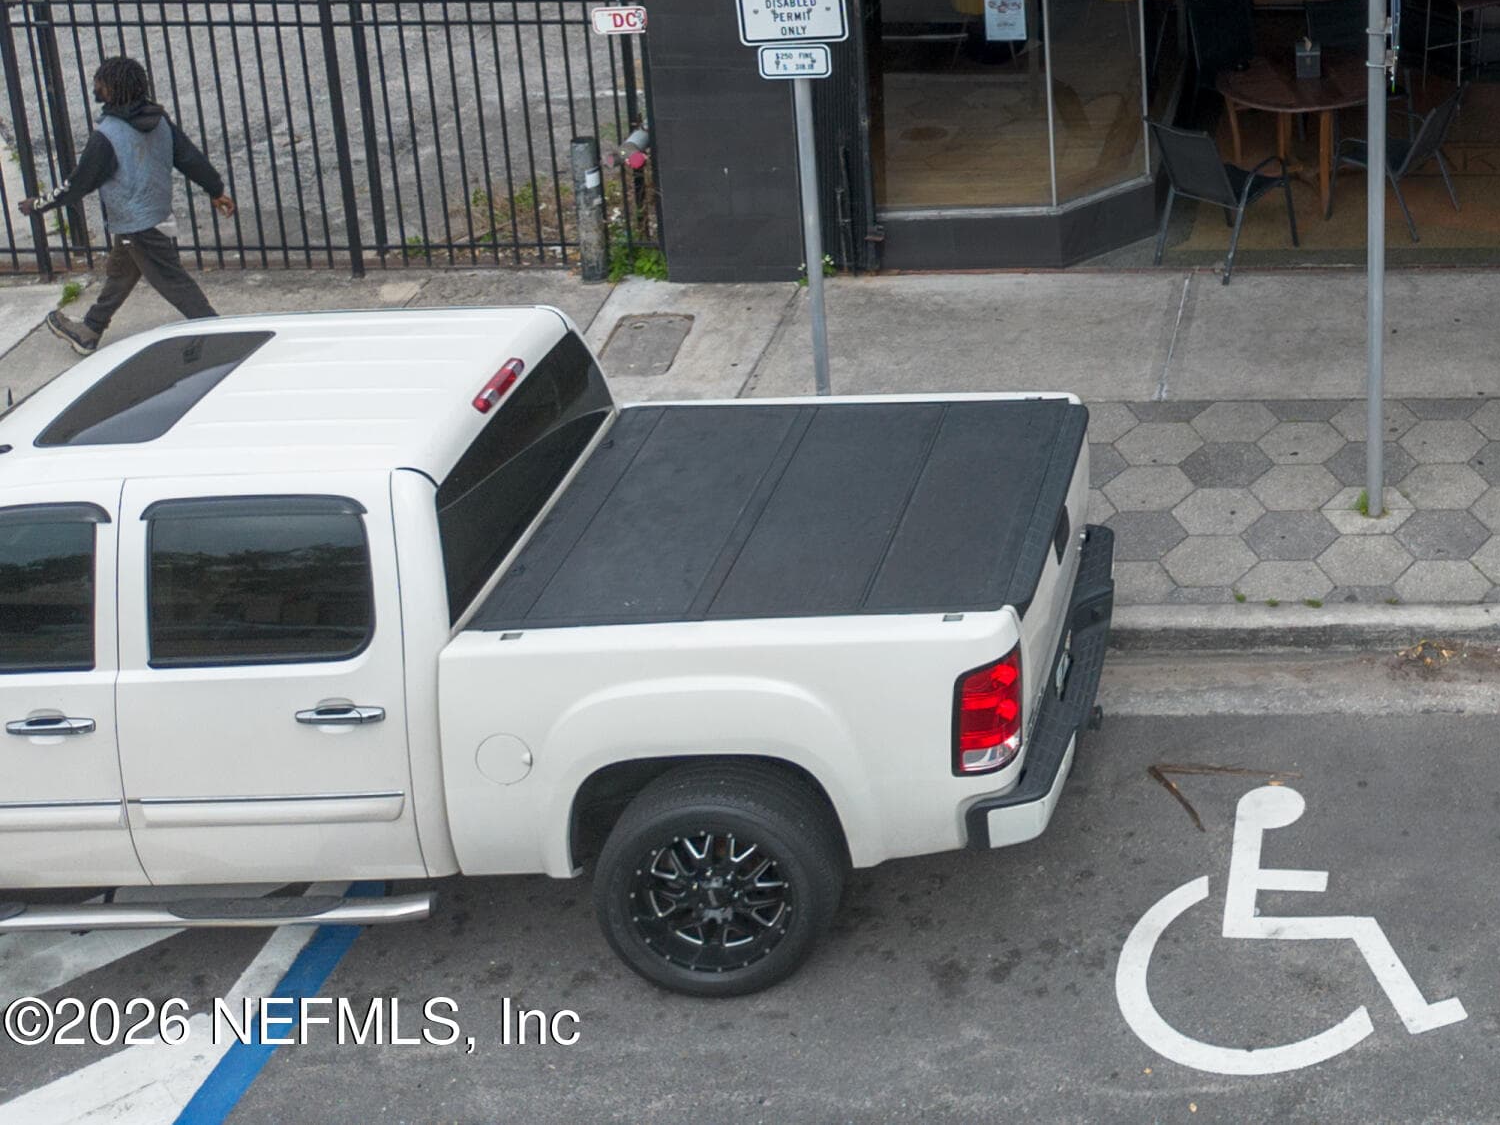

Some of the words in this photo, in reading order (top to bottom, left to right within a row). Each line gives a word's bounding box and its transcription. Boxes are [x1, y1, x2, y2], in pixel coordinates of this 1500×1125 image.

[773, 11, 812, 22] PERMIT
[781, 26, 807, 36] ONLY
[775, 52, 793, 60] $250
